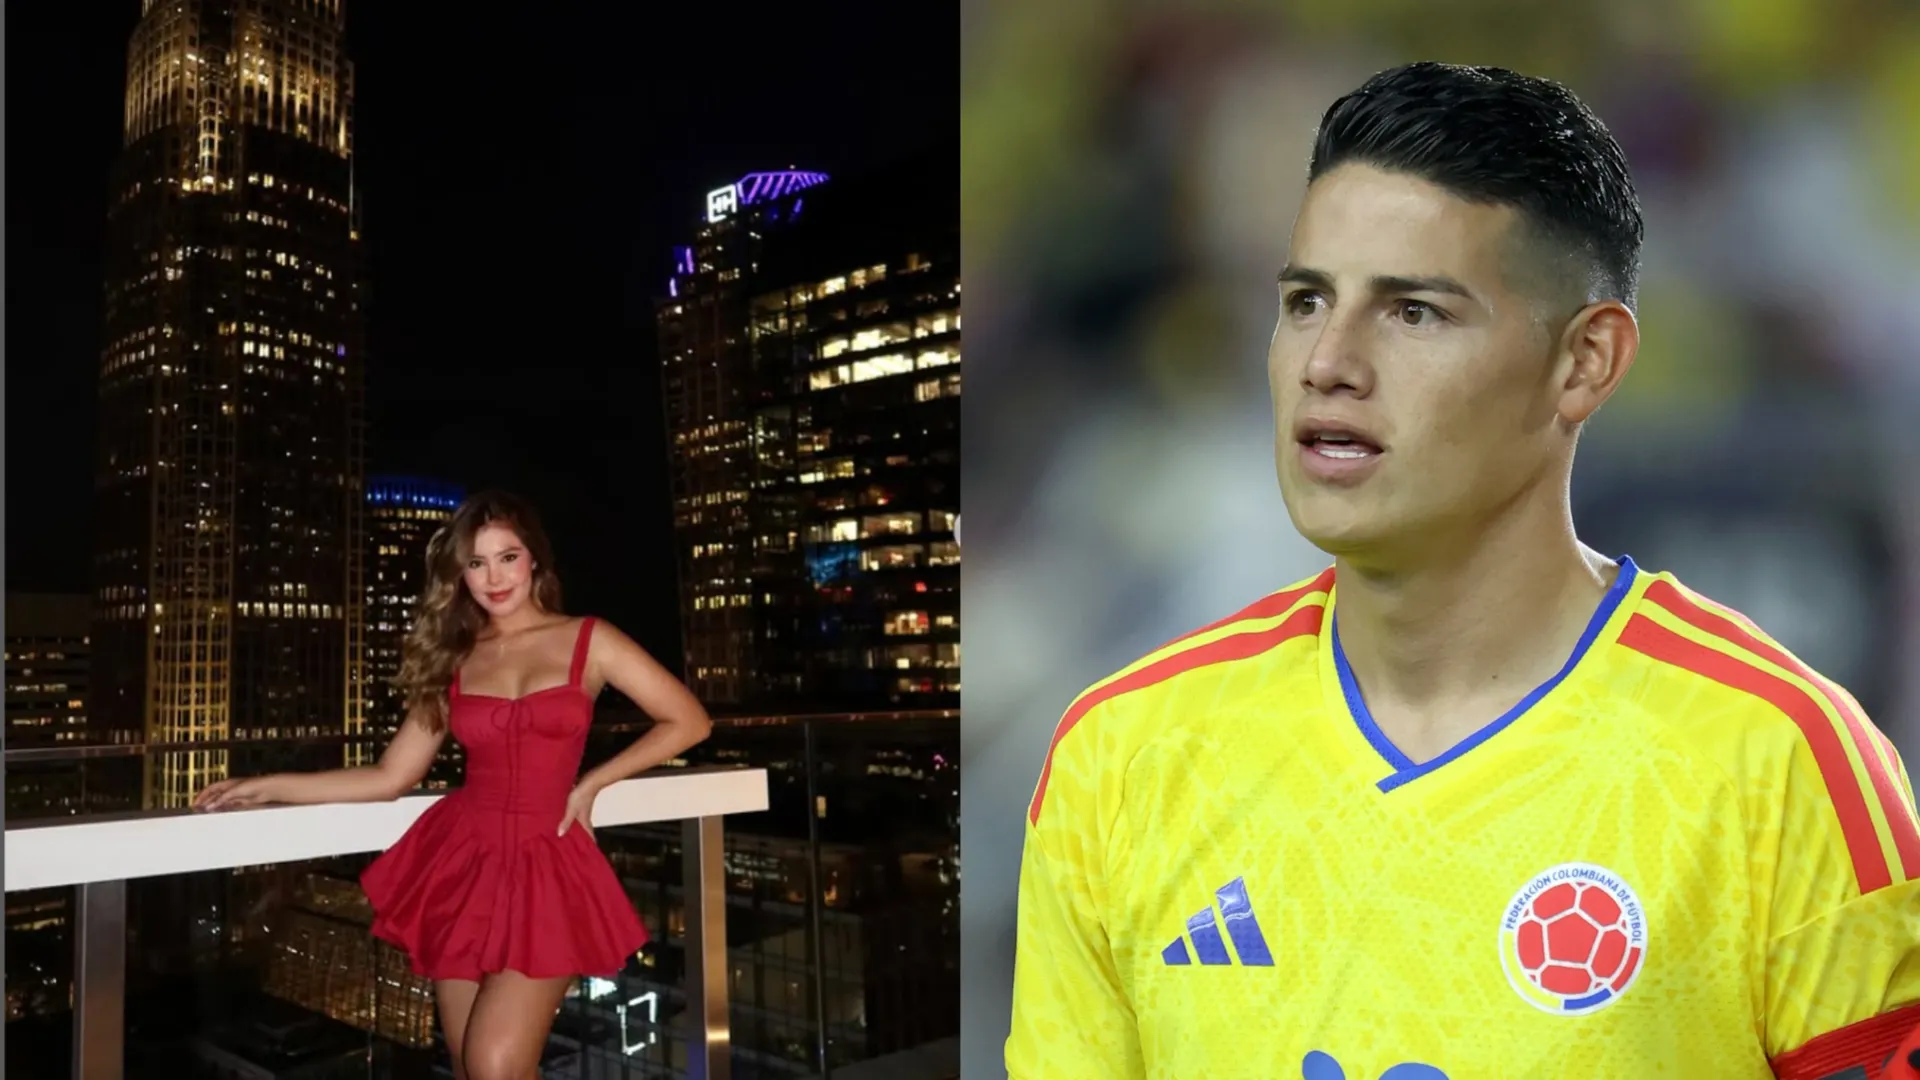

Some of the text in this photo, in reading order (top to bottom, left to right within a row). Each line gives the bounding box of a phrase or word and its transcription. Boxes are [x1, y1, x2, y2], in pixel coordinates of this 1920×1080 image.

[1505, 867, 1642, 943] FEDERACIÓN COLOMBIANA DE FÚTBOL
